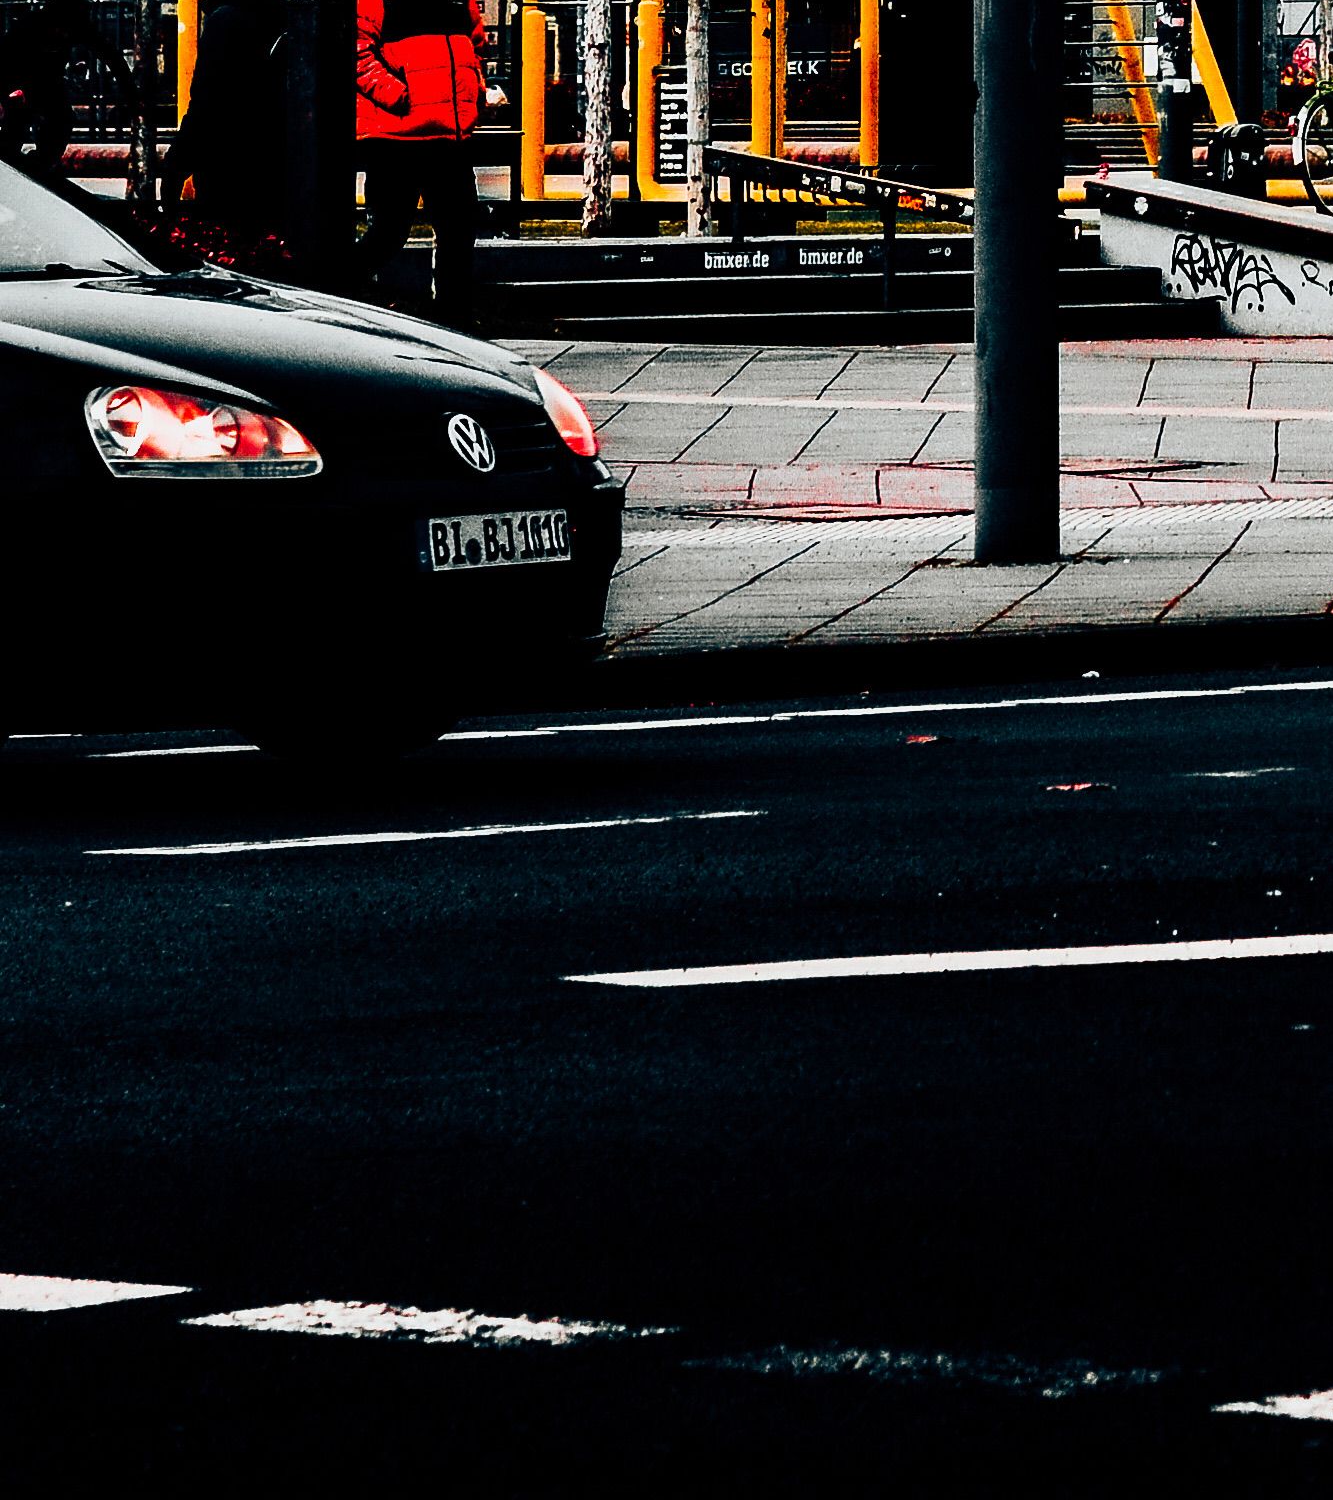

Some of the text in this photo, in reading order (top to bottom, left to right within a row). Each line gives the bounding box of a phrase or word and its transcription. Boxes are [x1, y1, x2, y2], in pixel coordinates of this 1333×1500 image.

[704, 252, 770, 269] bmxer.de
[799, 248, 864, 266] bmxer.de
[431, 521, 466, 567] BI
[482, 517, 516, 563] BJ
